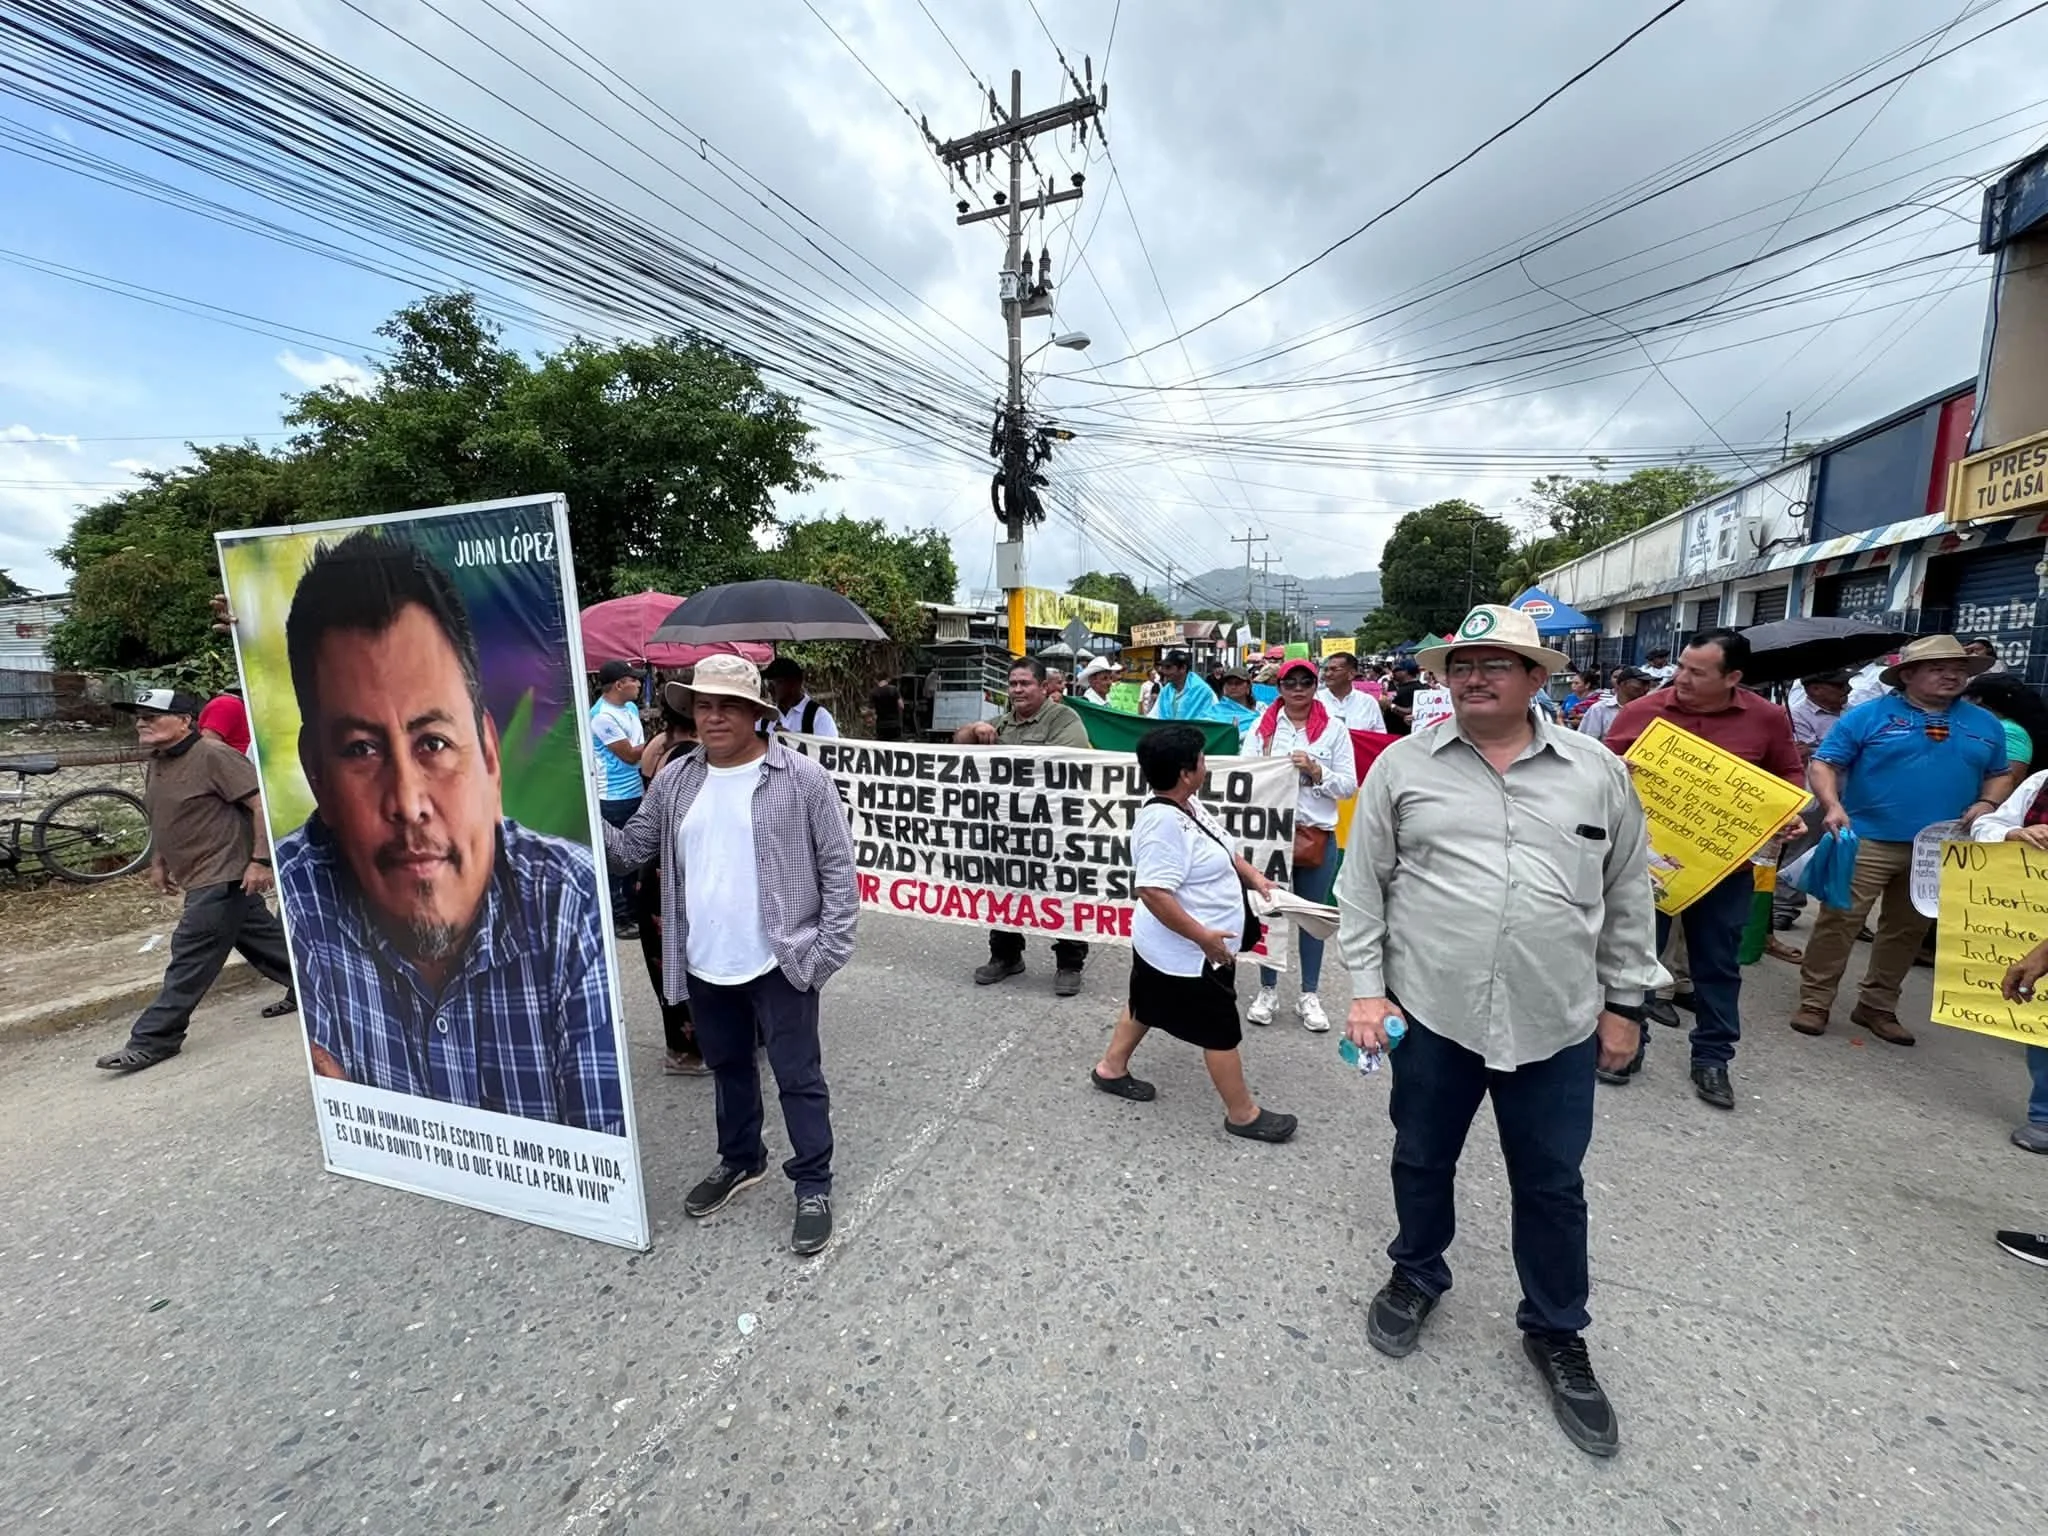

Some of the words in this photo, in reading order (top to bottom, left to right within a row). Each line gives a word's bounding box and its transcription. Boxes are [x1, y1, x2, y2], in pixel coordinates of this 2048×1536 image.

[1988, 445, 2048, 481] PRES
[1977, 484, 1997, 509] TU
[2002, 470, 2043, 502] CASA
[454, 537, 497, 567] JUAN
[500, 525, 555, 564] LÓPEZ
[819, 745, 981, 784] GRANDEZA
[989, 757, 1035, 787] DE
[1044, 760, 1093, 791] UN
[1658, 735, 1720, 776] Alexander
[1637, 747, 1655, 761] no
[1655, 752, 1669, 769] le
[1730, 792, 1753, 813] tus
[1642, 781, 1677, 810] Santa
[1671, 784, 1682, 795] a
[1682, 786, 1700, 805] los
[858, 781, 937, 815] MIDE
[942, 787, 1000, 822] POR
[1009, 792, 1053, 824] LA
[858, 811, 1061, 863] TERRITORIO,
[1943, 844, 1988, 871] NO
[918, 850, 937, 876] Y
[942, 853, 1048, 892] HONOR
[1055, 864, 1098, 897] DE
[889, 877, 1066, 932] GUAYMAS
[1969, 879, 2048, 913] Liberta
[1939, 990, 1997, 1025] Fuera
[2007, 1007, 2039, 1034] la
[336, 1123, 348, 1141] ES
[349, 1127, 361, 1145] LO
[363, 1128, 385, 1151] MÁS
[386, 1135, 422, 1160] BONITO
[423, 1143, 432, 1163] Y
[434, 1147, 454, 1168] POR
[456, 1152, 470, 1172] LO
[472, 1155, 494, 1177] QUE
[496, 1159, 524, 1185] VALE
[526, 1166, 541, 1189] LA
[543, 1170, 574, 1196] PENA
[342, 1102, 355, 1121] EL
[356, 1105, 376, 1126] ADN
[378, 1109, 420, 1137] HUMANO
[421, 1119, 448, 1143] ESTÁ
[450, 1126, 494, 1153] ESCRITO
[496, 1136, 510, 1157] EL
[513, 1140, 545, 1164] AMOR
[548, 1146, 571, 1170] POR
[574, 1152, 590, 1174] LA
[592, 1155, 626, 1184] VIDA,
